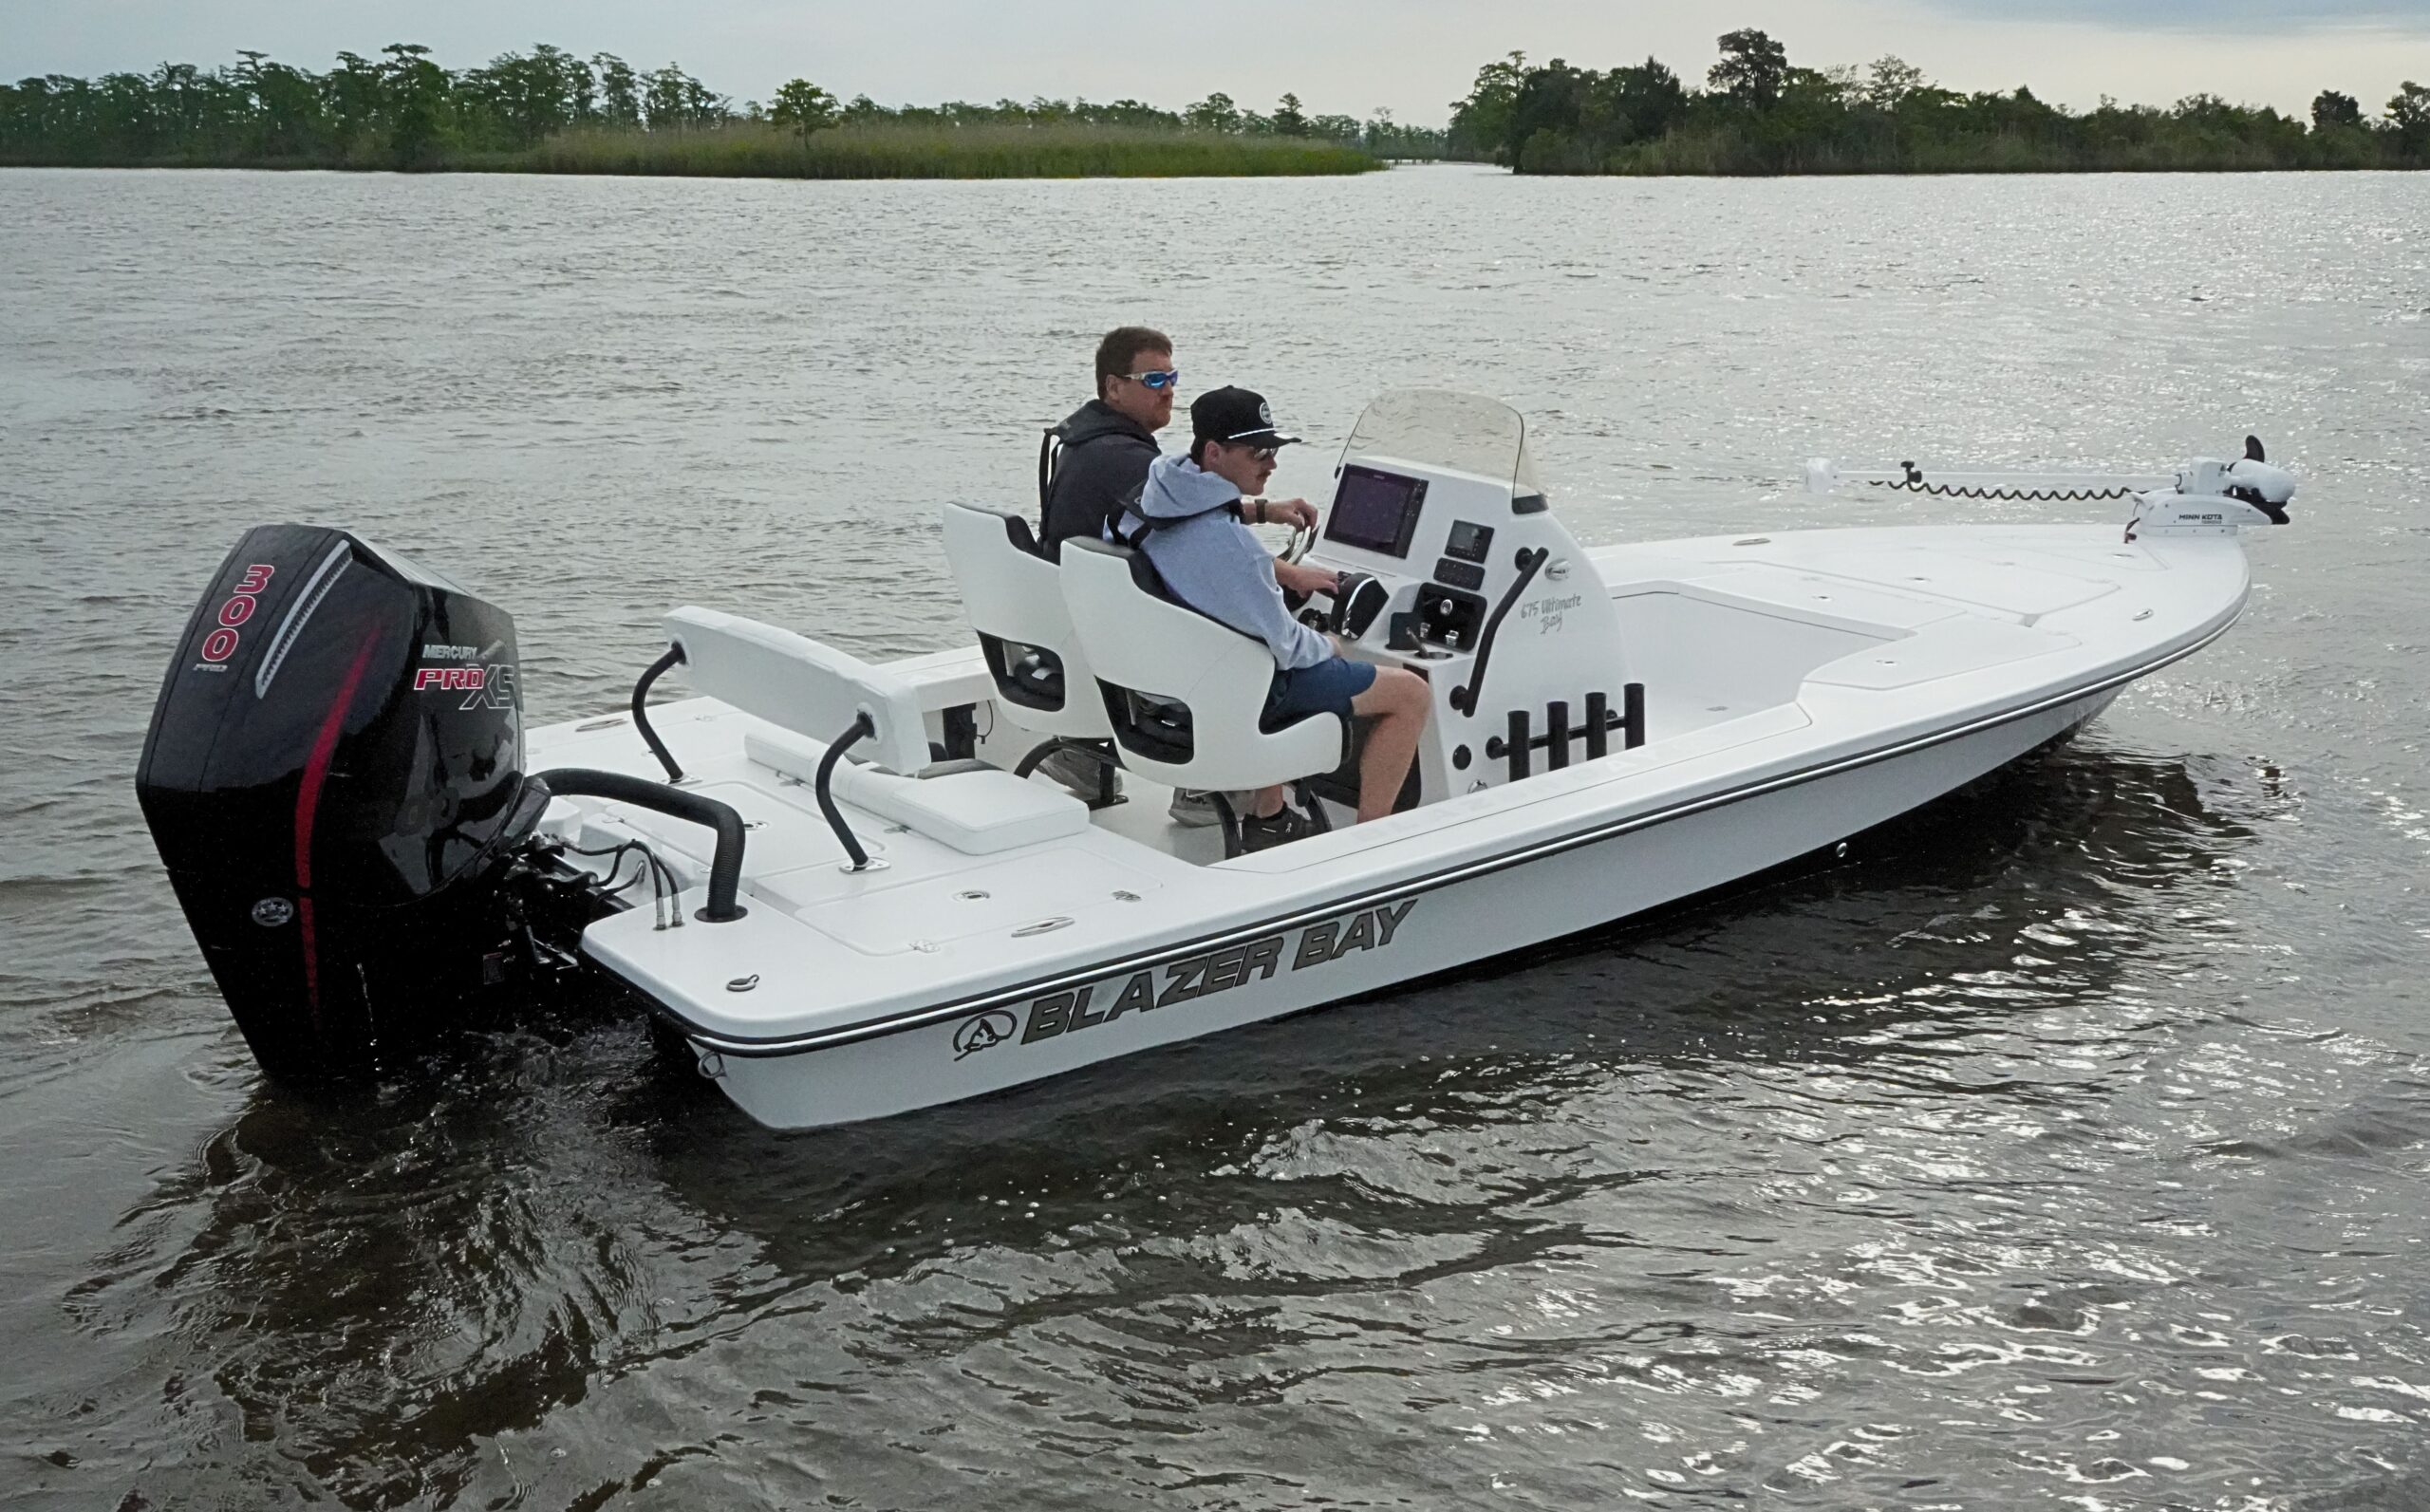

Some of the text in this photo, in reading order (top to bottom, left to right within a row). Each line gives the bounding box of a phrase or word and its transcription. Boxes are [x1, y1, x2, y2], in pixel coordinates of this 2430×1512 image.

[201, 564, 274, 662] 300
[1520, 600, 1540, 619] 675
[1541, 610, 1562, 634] Bay
[422, 644, 477, 660] MERCURY
[414, 663, 514, 710] PRO XS
[1020, 899, 1419, 1046] BLAZER BAY
